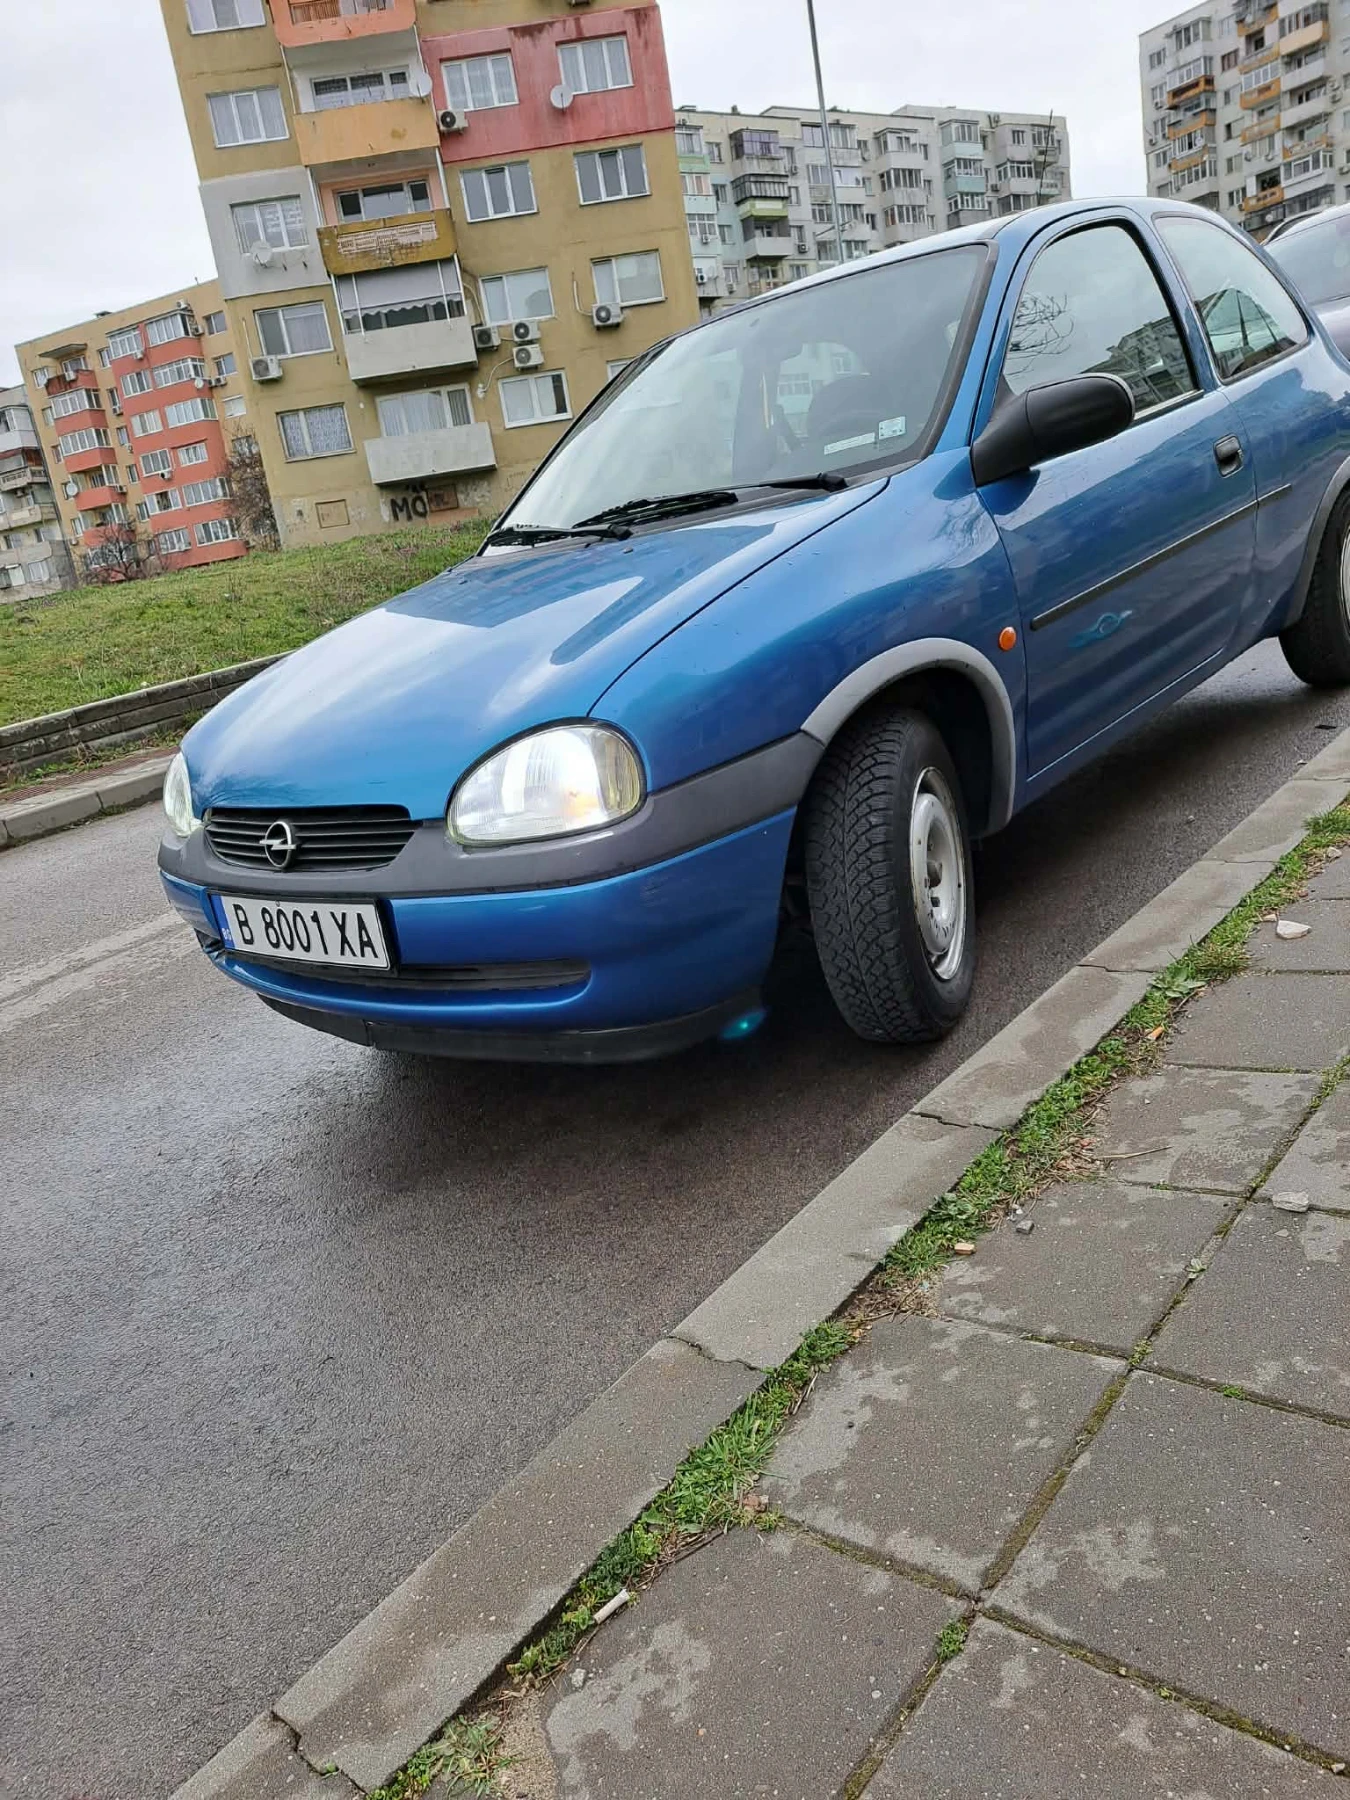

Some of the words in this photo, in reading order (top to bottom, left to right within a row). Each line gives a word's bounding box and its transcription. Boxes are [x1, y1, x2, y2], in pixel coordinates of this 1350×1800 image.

[232, 904, 254, 945] B
[261, 907, 328, 955] 8001
[330, 911, 379, 958] XA
